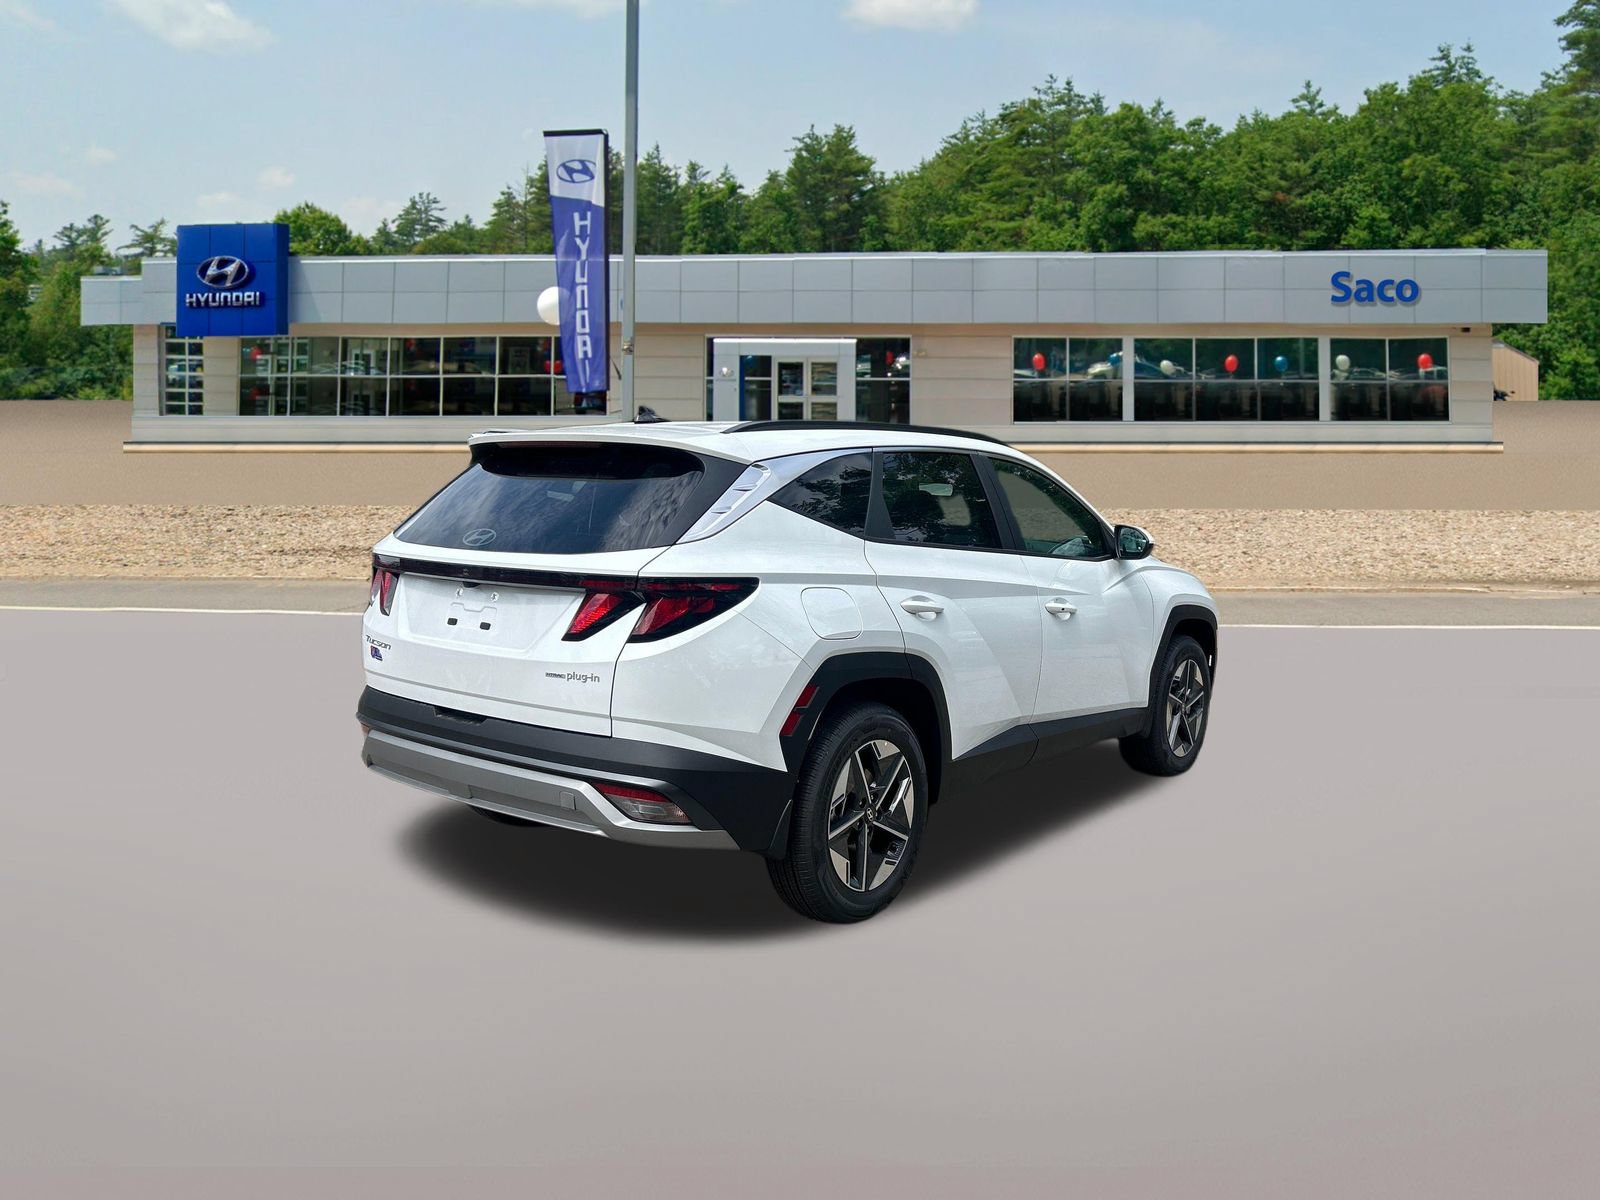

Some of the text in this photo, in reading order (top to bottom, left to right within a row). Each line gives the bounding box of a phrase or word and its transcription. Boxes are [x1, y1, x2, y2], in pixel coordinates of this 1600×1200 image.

[573, 211, 592, 383] HYUNDAI
[1330, 270, 1420, 303] Saco
[185, 291, 260, 307] HYUNDAI
[566, 671, 600, 683] plug-in
